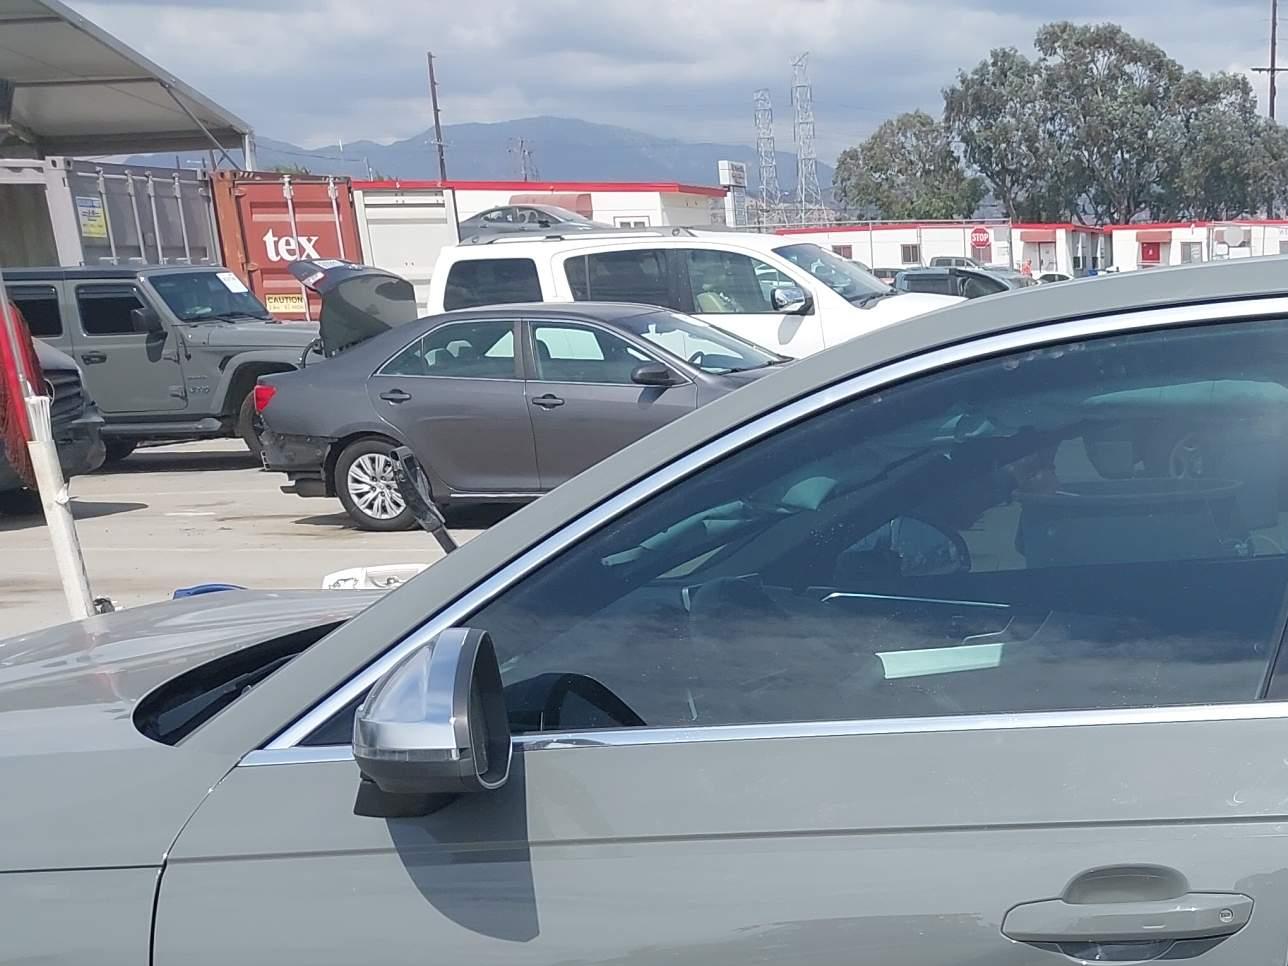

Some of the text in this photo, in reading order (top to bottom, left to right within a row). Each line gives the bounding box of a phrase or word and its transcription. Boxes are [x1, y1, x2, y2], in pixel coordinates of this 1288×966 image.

[971, 232, 989, 242] STOP
[262, 227, 320, 262] tex
[267, 295, 303, 304] CAUTION
